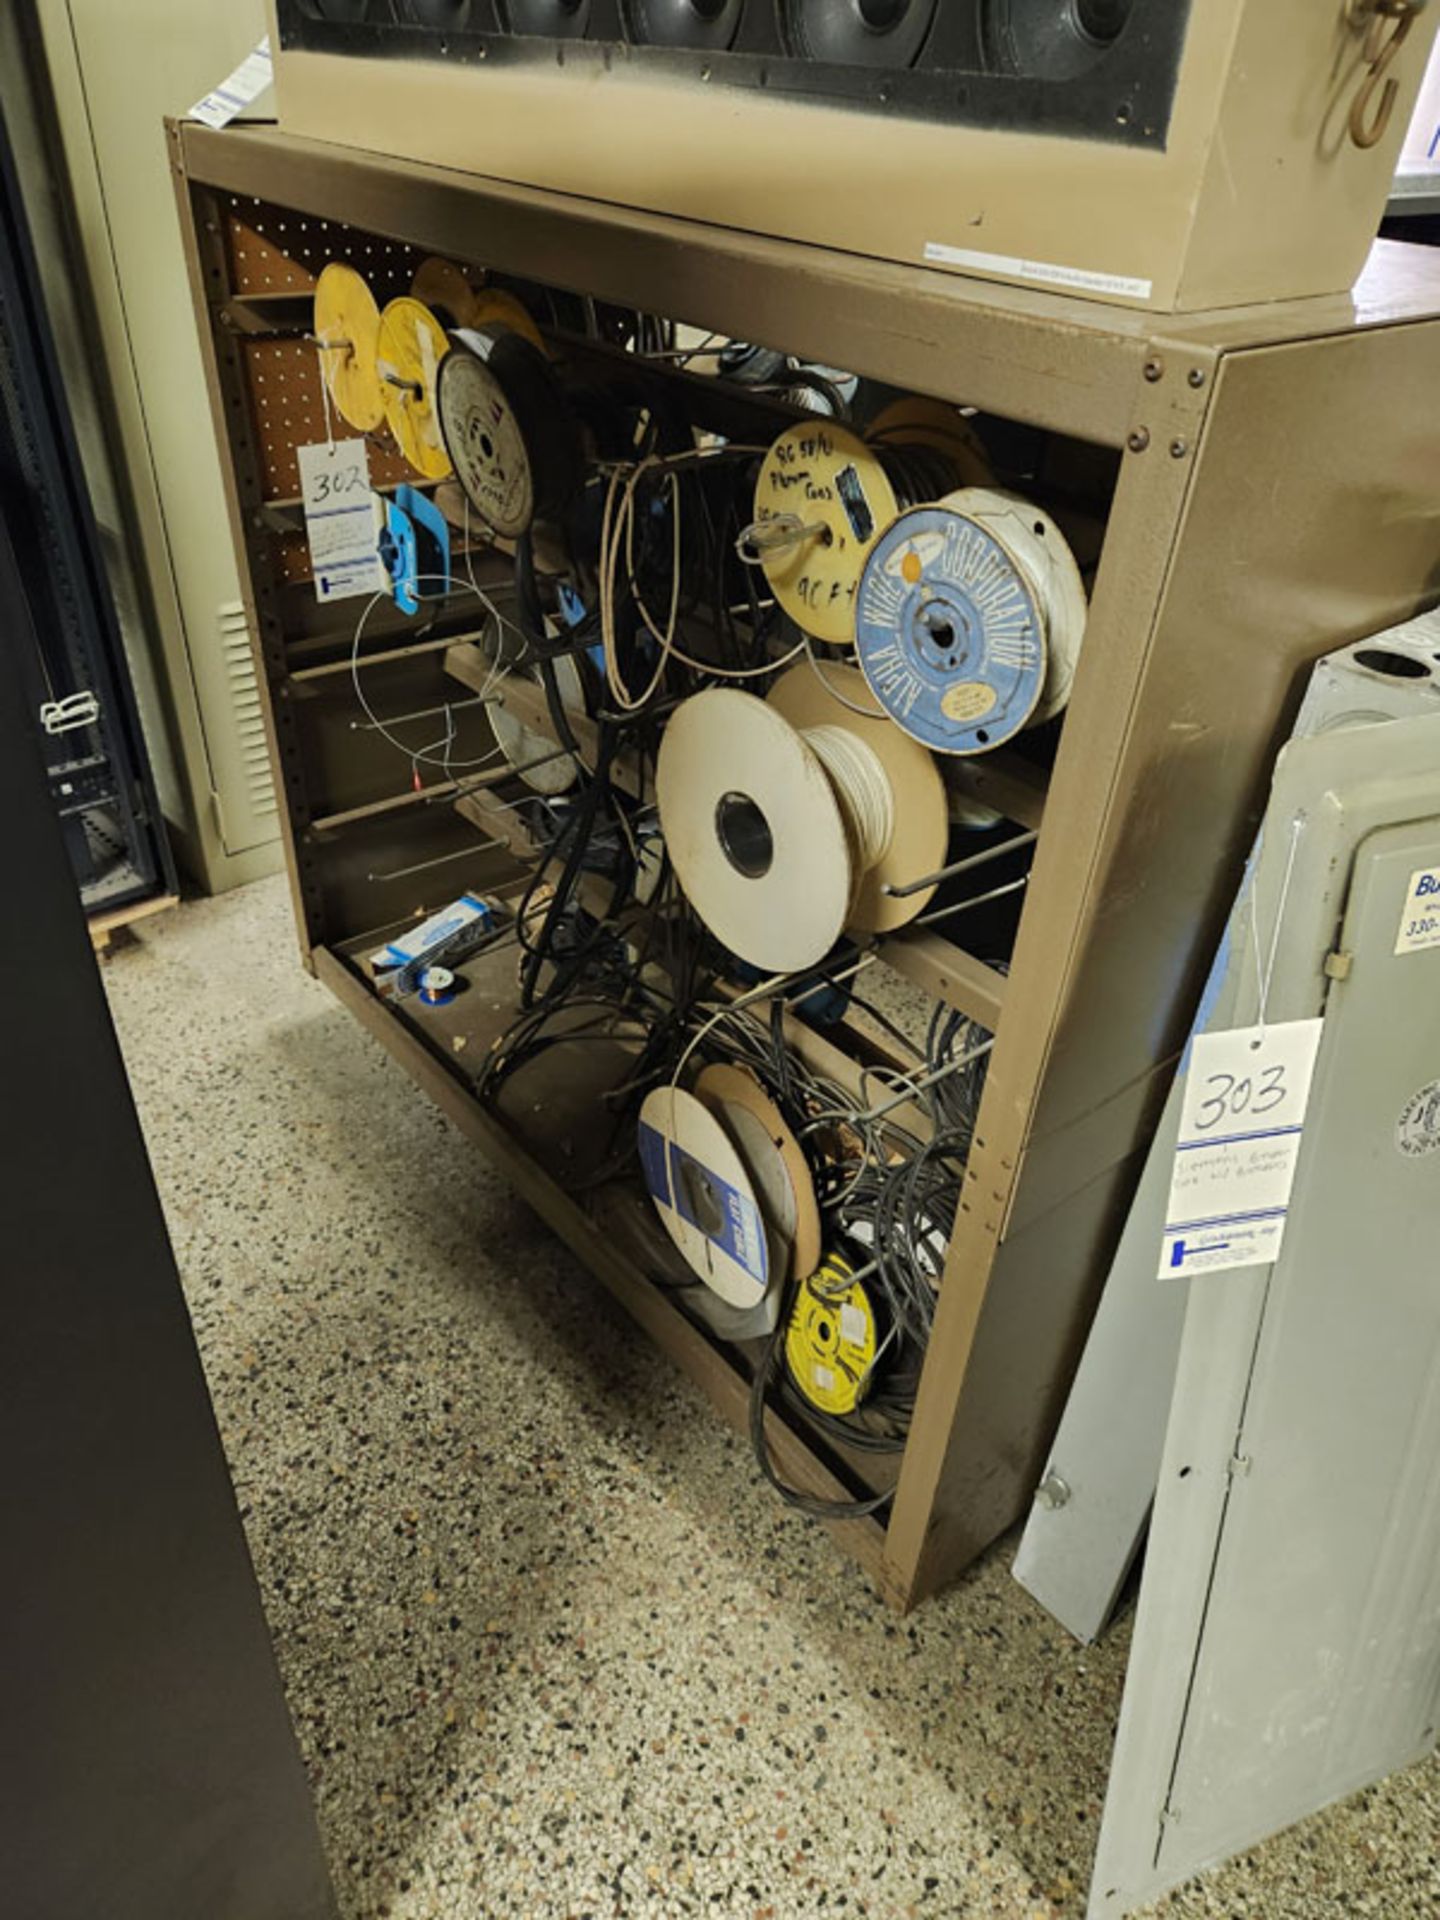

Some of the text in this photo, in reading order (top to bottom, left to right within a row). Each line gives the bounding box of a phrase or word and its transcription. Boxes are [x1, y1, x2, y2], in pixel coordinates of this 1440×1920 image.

[312, 465, 367, 503] 302
[863, 559, 906, 629] WIRE
[942, 520, 1037, 672] CORPORATION
[866, 643, 924, 719] ALPHA
[1195, 1065, 1287, 1129] 303
